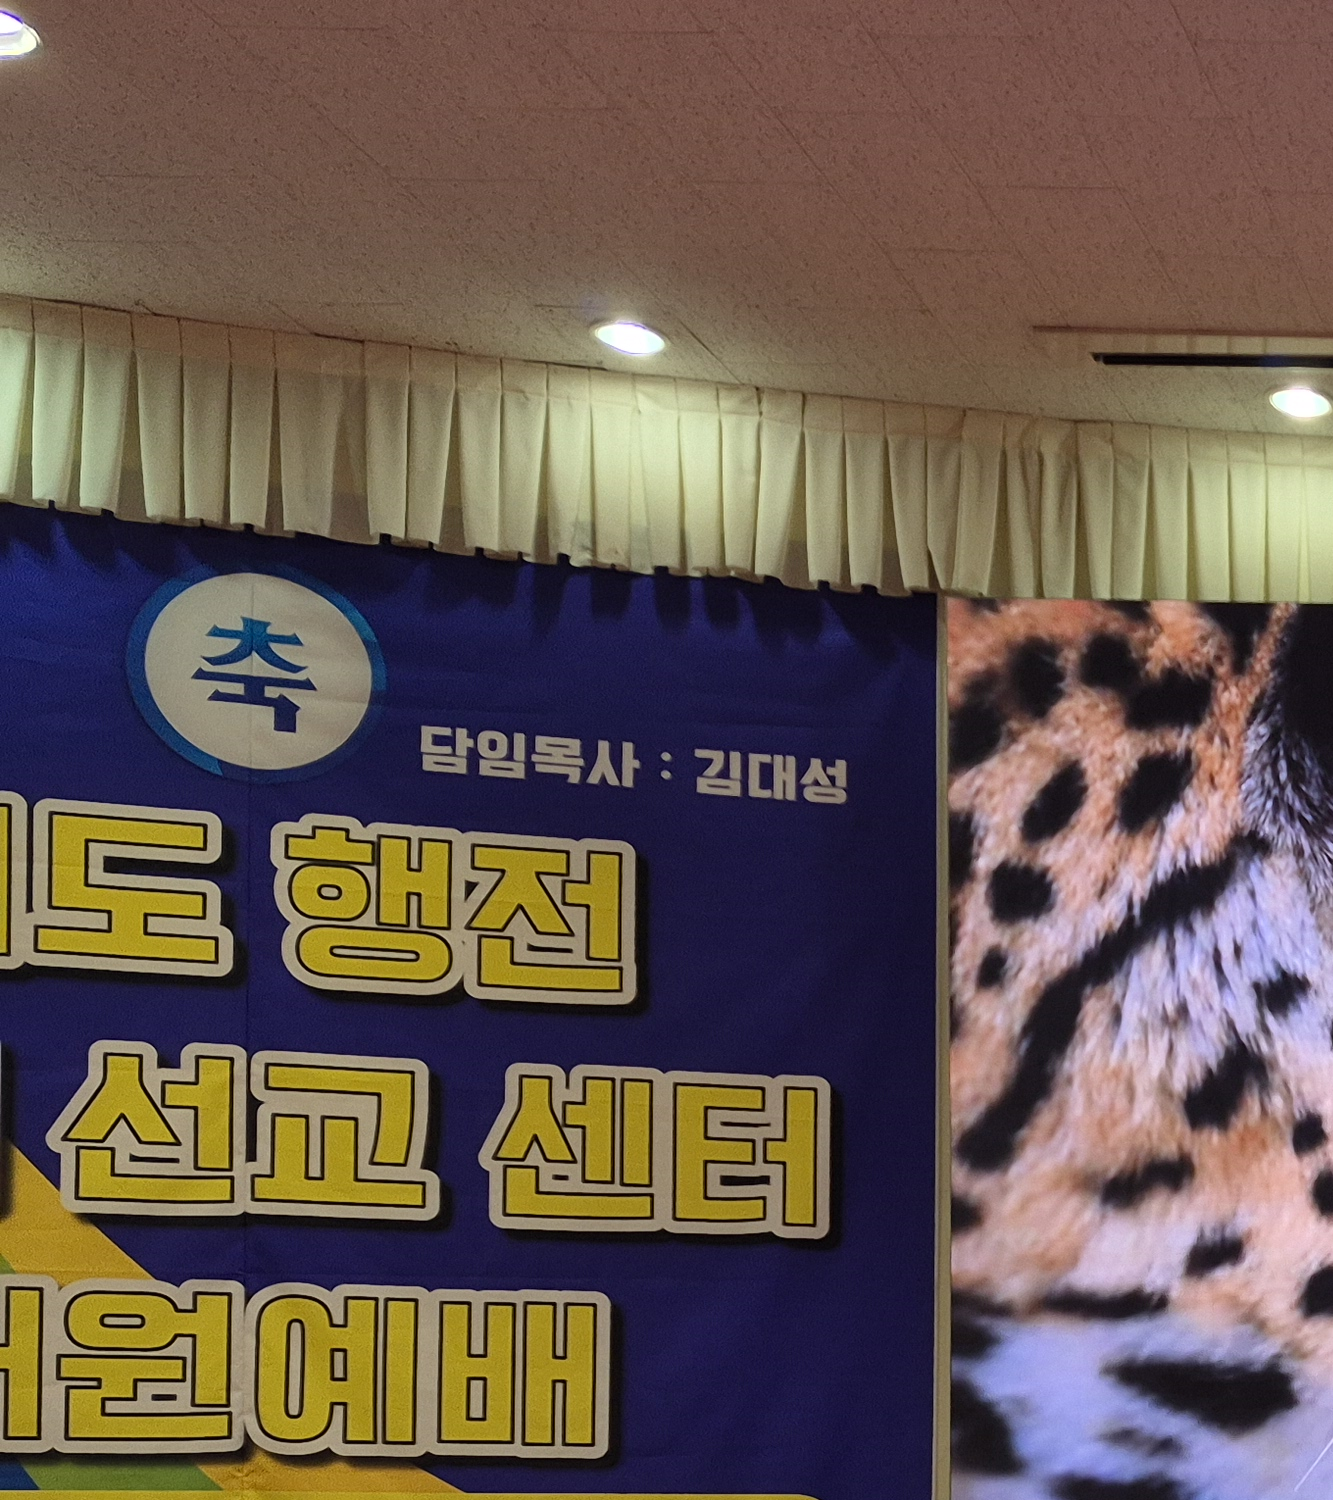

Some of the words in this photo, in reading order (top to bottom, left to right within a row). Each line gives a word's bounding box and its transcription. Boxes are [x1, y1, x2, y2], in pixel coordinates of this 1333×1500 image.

[191, 616, 318, 733] 축
[419, 724, 641, 789] 담임목사
[693, 748, 850, 804] 김대성
[0, 790, 234, 977] 도
[270, 812, 637, 1005] 행전
[45, 1039, 440, 1221] 선교
[478, 1062, 832, 1239] 센터
